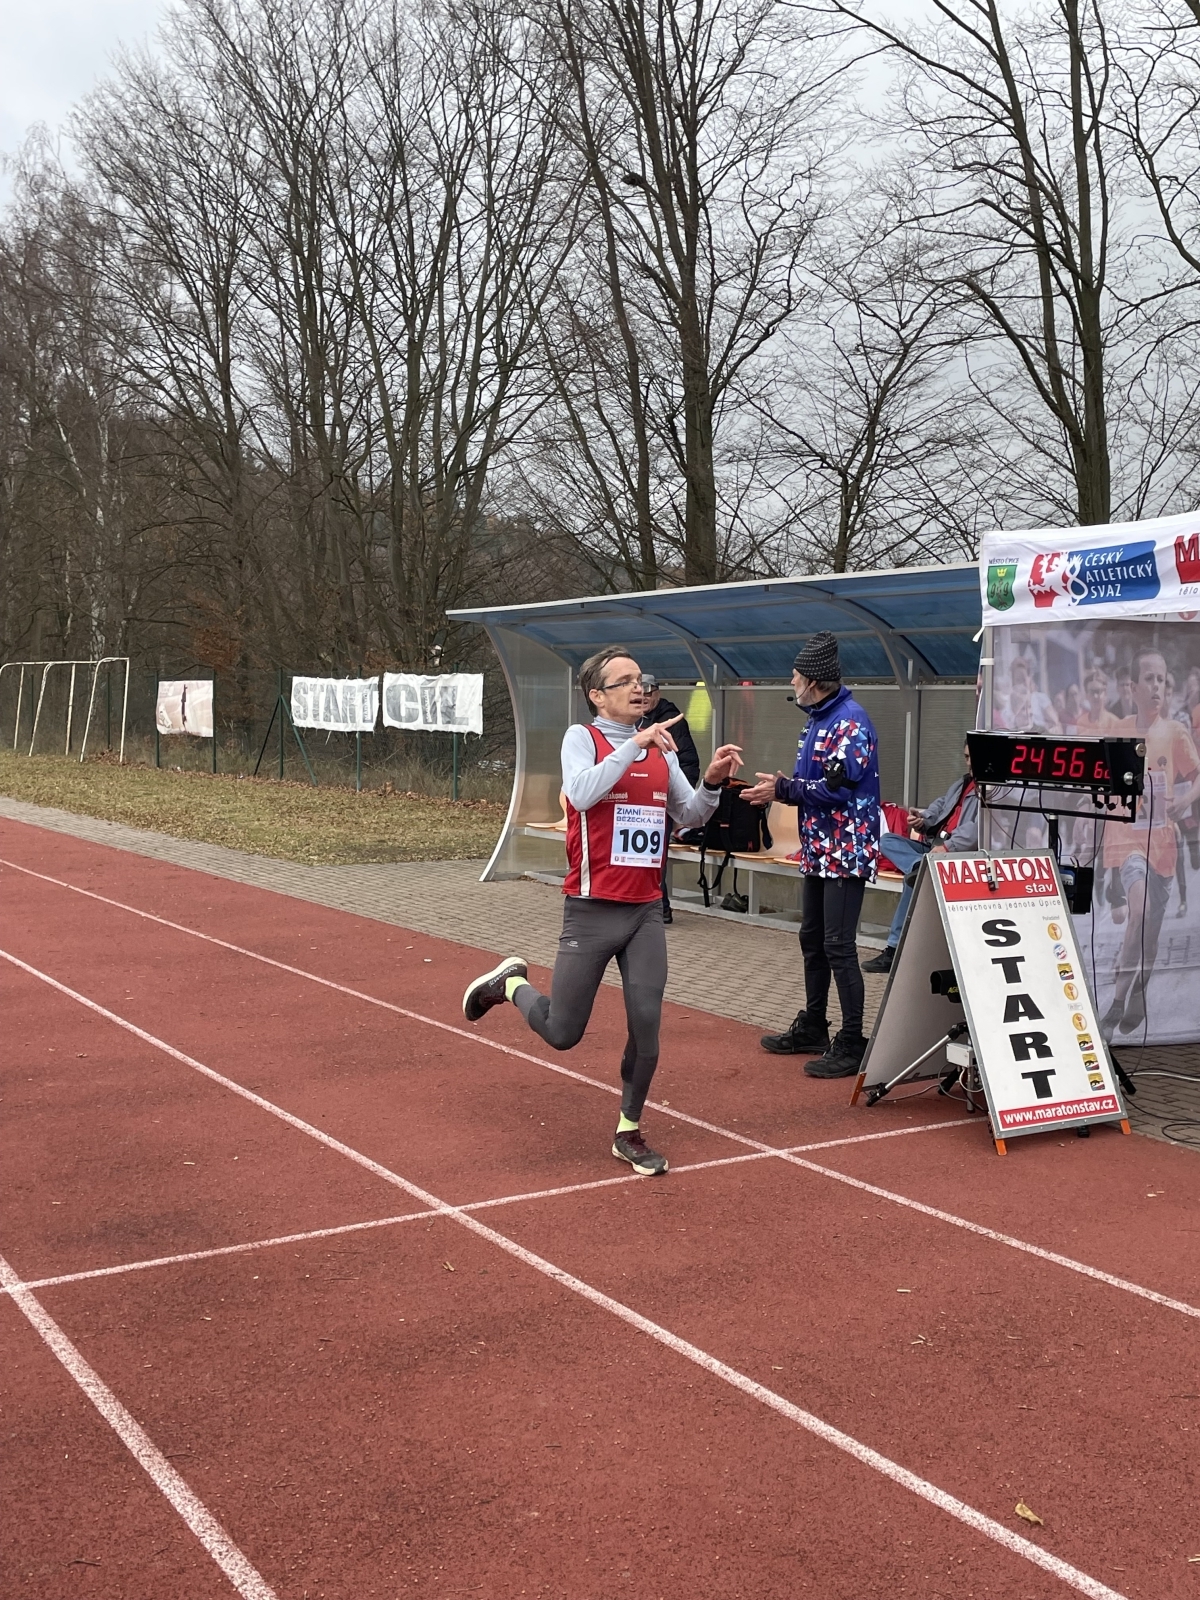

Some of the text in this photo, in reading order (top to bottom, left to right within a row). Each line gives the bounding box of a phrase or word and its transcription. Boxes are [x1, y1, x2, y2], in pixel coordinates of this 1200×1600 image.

[1085, 548, 1123, 567] ČESKÝ
[1086, 560, 1152, 583] ATLETICKÝ
[1091, 584, 1122, 599] SVAZ
[293, 682, 378, 724] START
[1011, 745, 1045, 774] 24
[1052, 747, 1086, 778] 56
[616, 807, 642, 816] ZIMNÍ
[619, 829, 661, 855] 109
[936, 857, 1055, 884] MARATON
[1025, 882, 1053, 894] stav
[1005, 901, 1036, 910] jednota
[981, 918, 1057, 1100] START
[1003, 1099, 1115, 1124] www.maratonstav.cz
